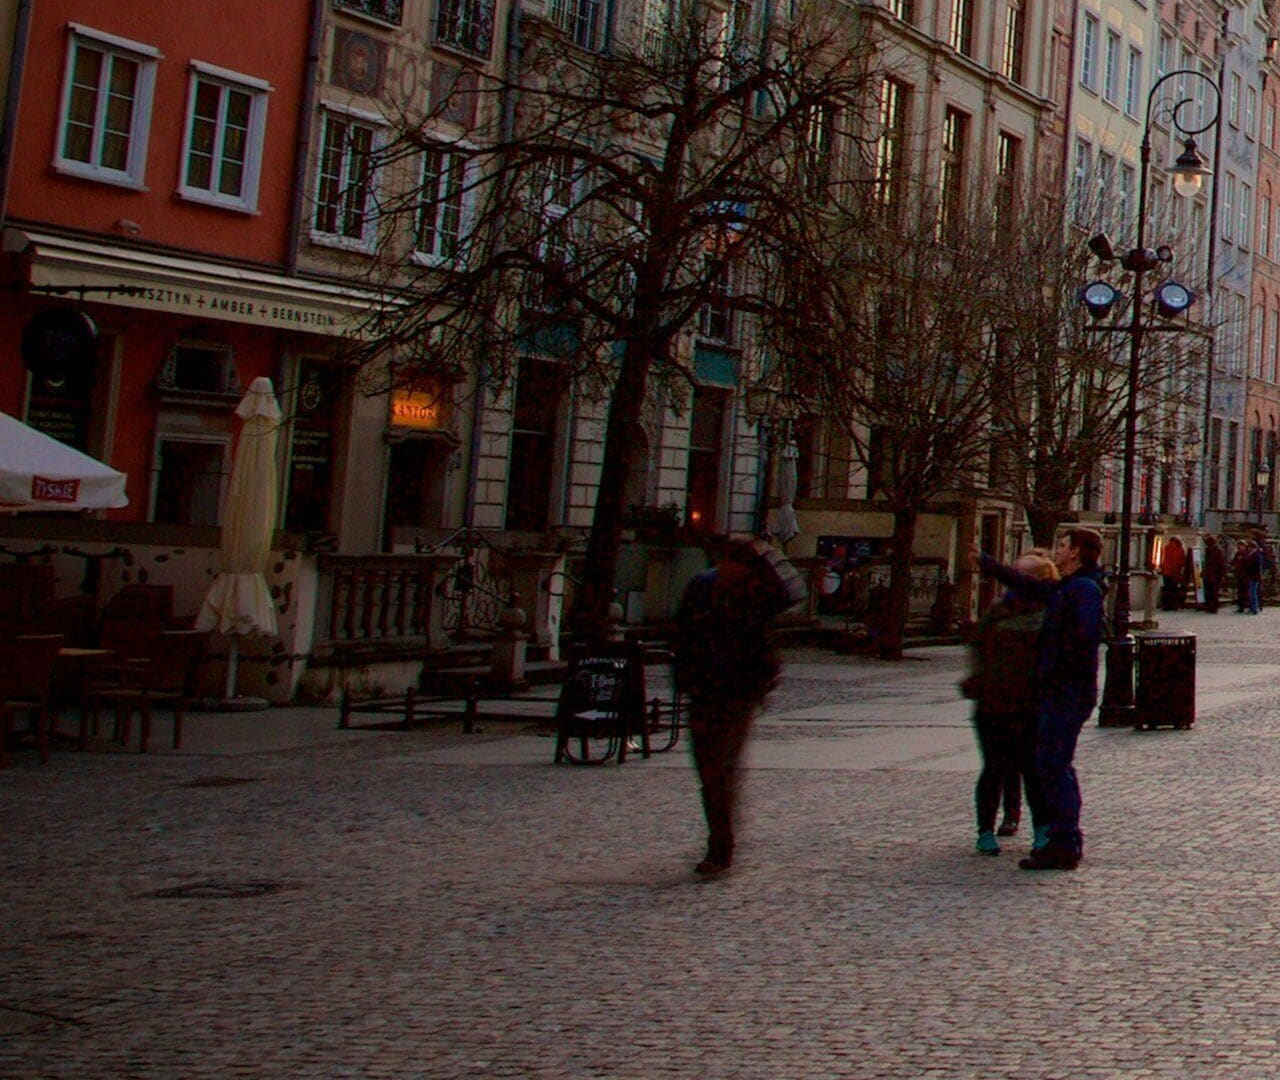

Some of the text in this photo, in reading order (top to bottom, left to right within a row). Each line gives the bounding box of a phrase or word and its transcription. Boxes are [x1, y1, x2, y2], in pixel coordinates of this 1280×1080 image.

[211, 298, 254, 316] AMBER
[272, 307, 335, 325] BERNSTEIN
[34, 480, 76, 501] TYSKIE
